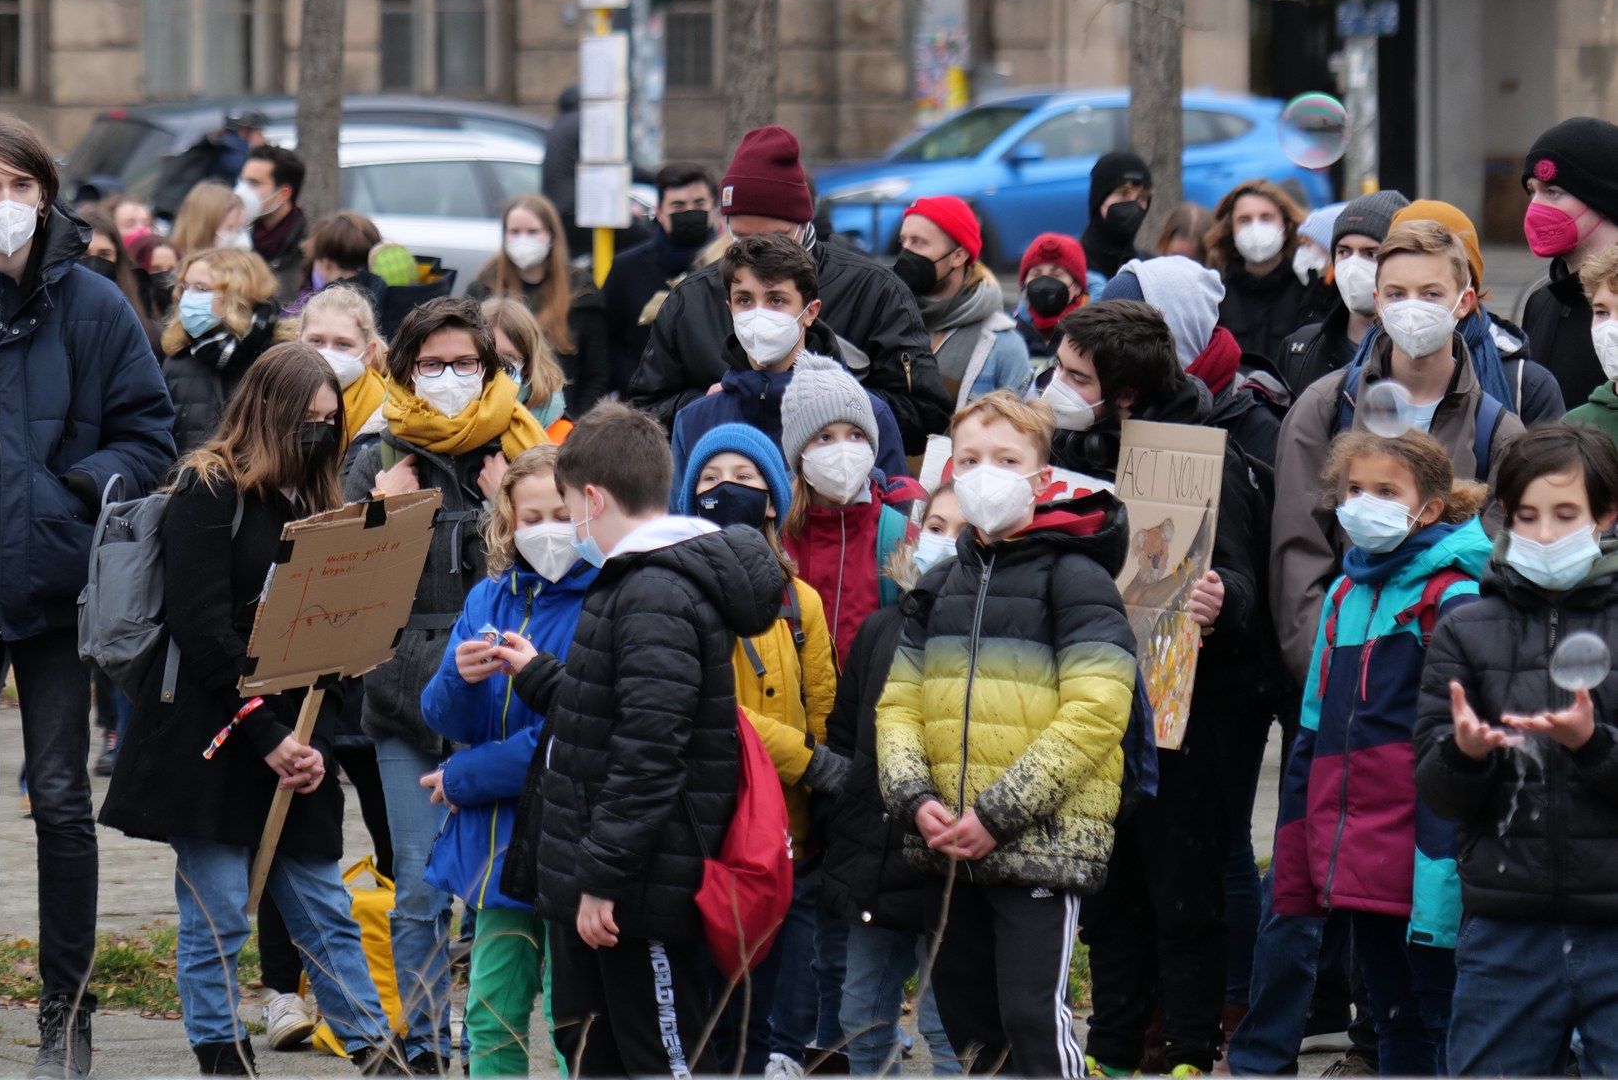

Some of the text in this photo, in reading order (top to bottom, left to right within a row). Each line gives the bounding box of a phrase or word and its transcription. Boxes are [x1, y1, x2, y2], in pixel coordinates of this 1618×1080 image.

[1117, 447, 1164, 497] ACT
[1167, 453, 1215, 502] NOW!
[648, 943, 681, 1049] WORLDWIDE
